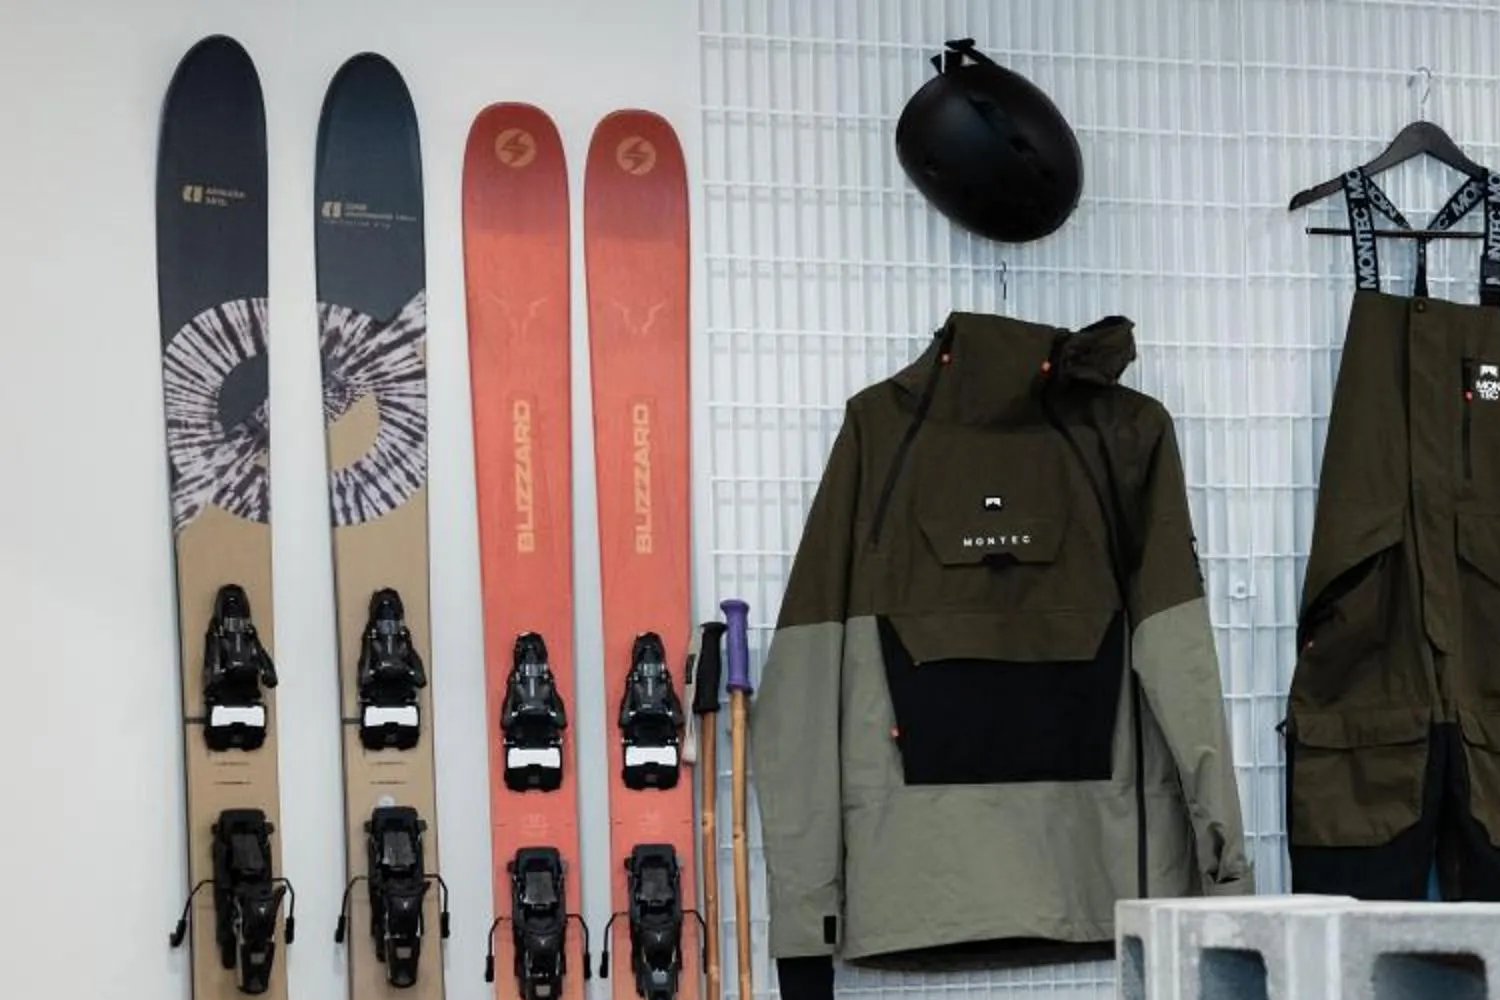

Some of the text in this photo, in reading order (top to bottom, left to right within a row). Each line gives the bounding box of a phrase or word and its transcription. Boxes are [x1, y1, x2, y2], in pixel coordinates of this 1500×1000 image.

[1352, 206, 1378, 289] MONTEC
[514, 400, 535, 553] BLIZZARD
[633, 403, 652, 554] BLIZZARD
[963, 535, 1031, 547] MONTEC
